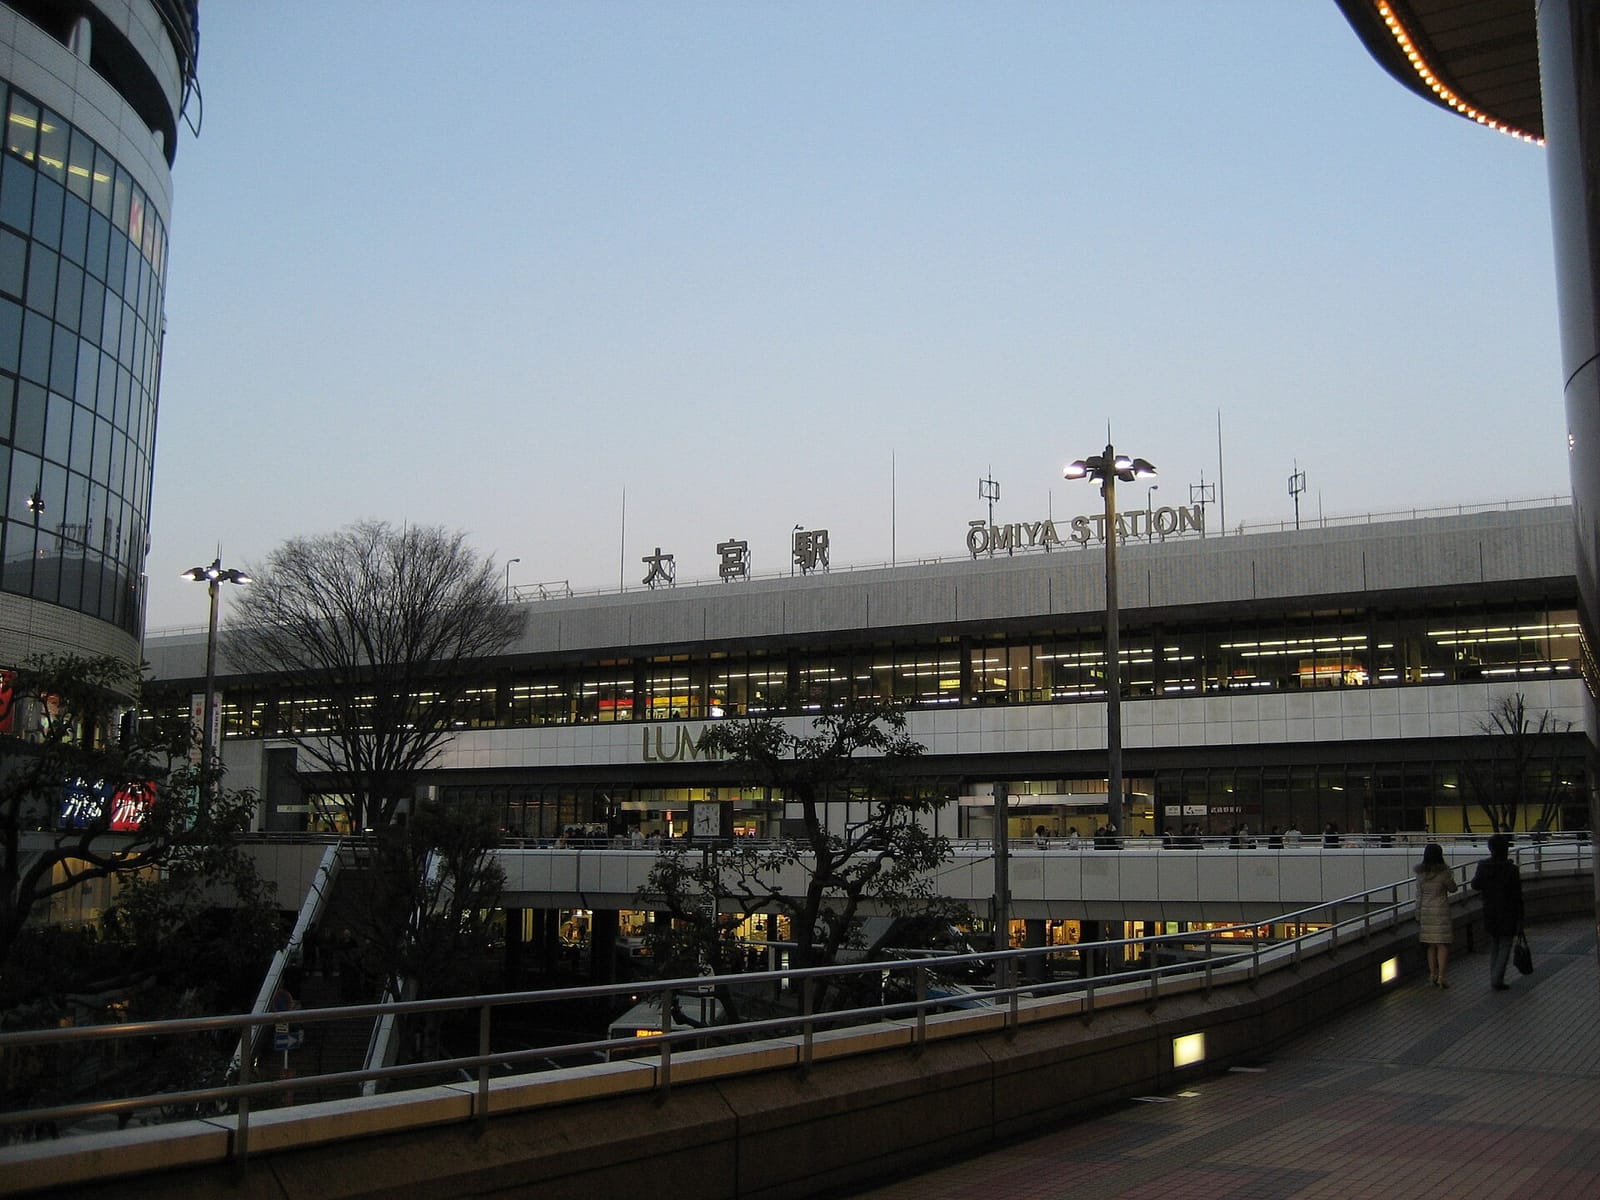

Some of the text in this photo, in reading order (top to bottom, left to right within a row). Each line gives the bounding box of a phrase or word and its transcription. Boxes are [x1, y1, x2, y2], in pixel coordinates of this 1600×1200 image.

[966, 504, 1202, 554] ŌMIYA STATION
[642, 529, 829, 585] 大宮駅
